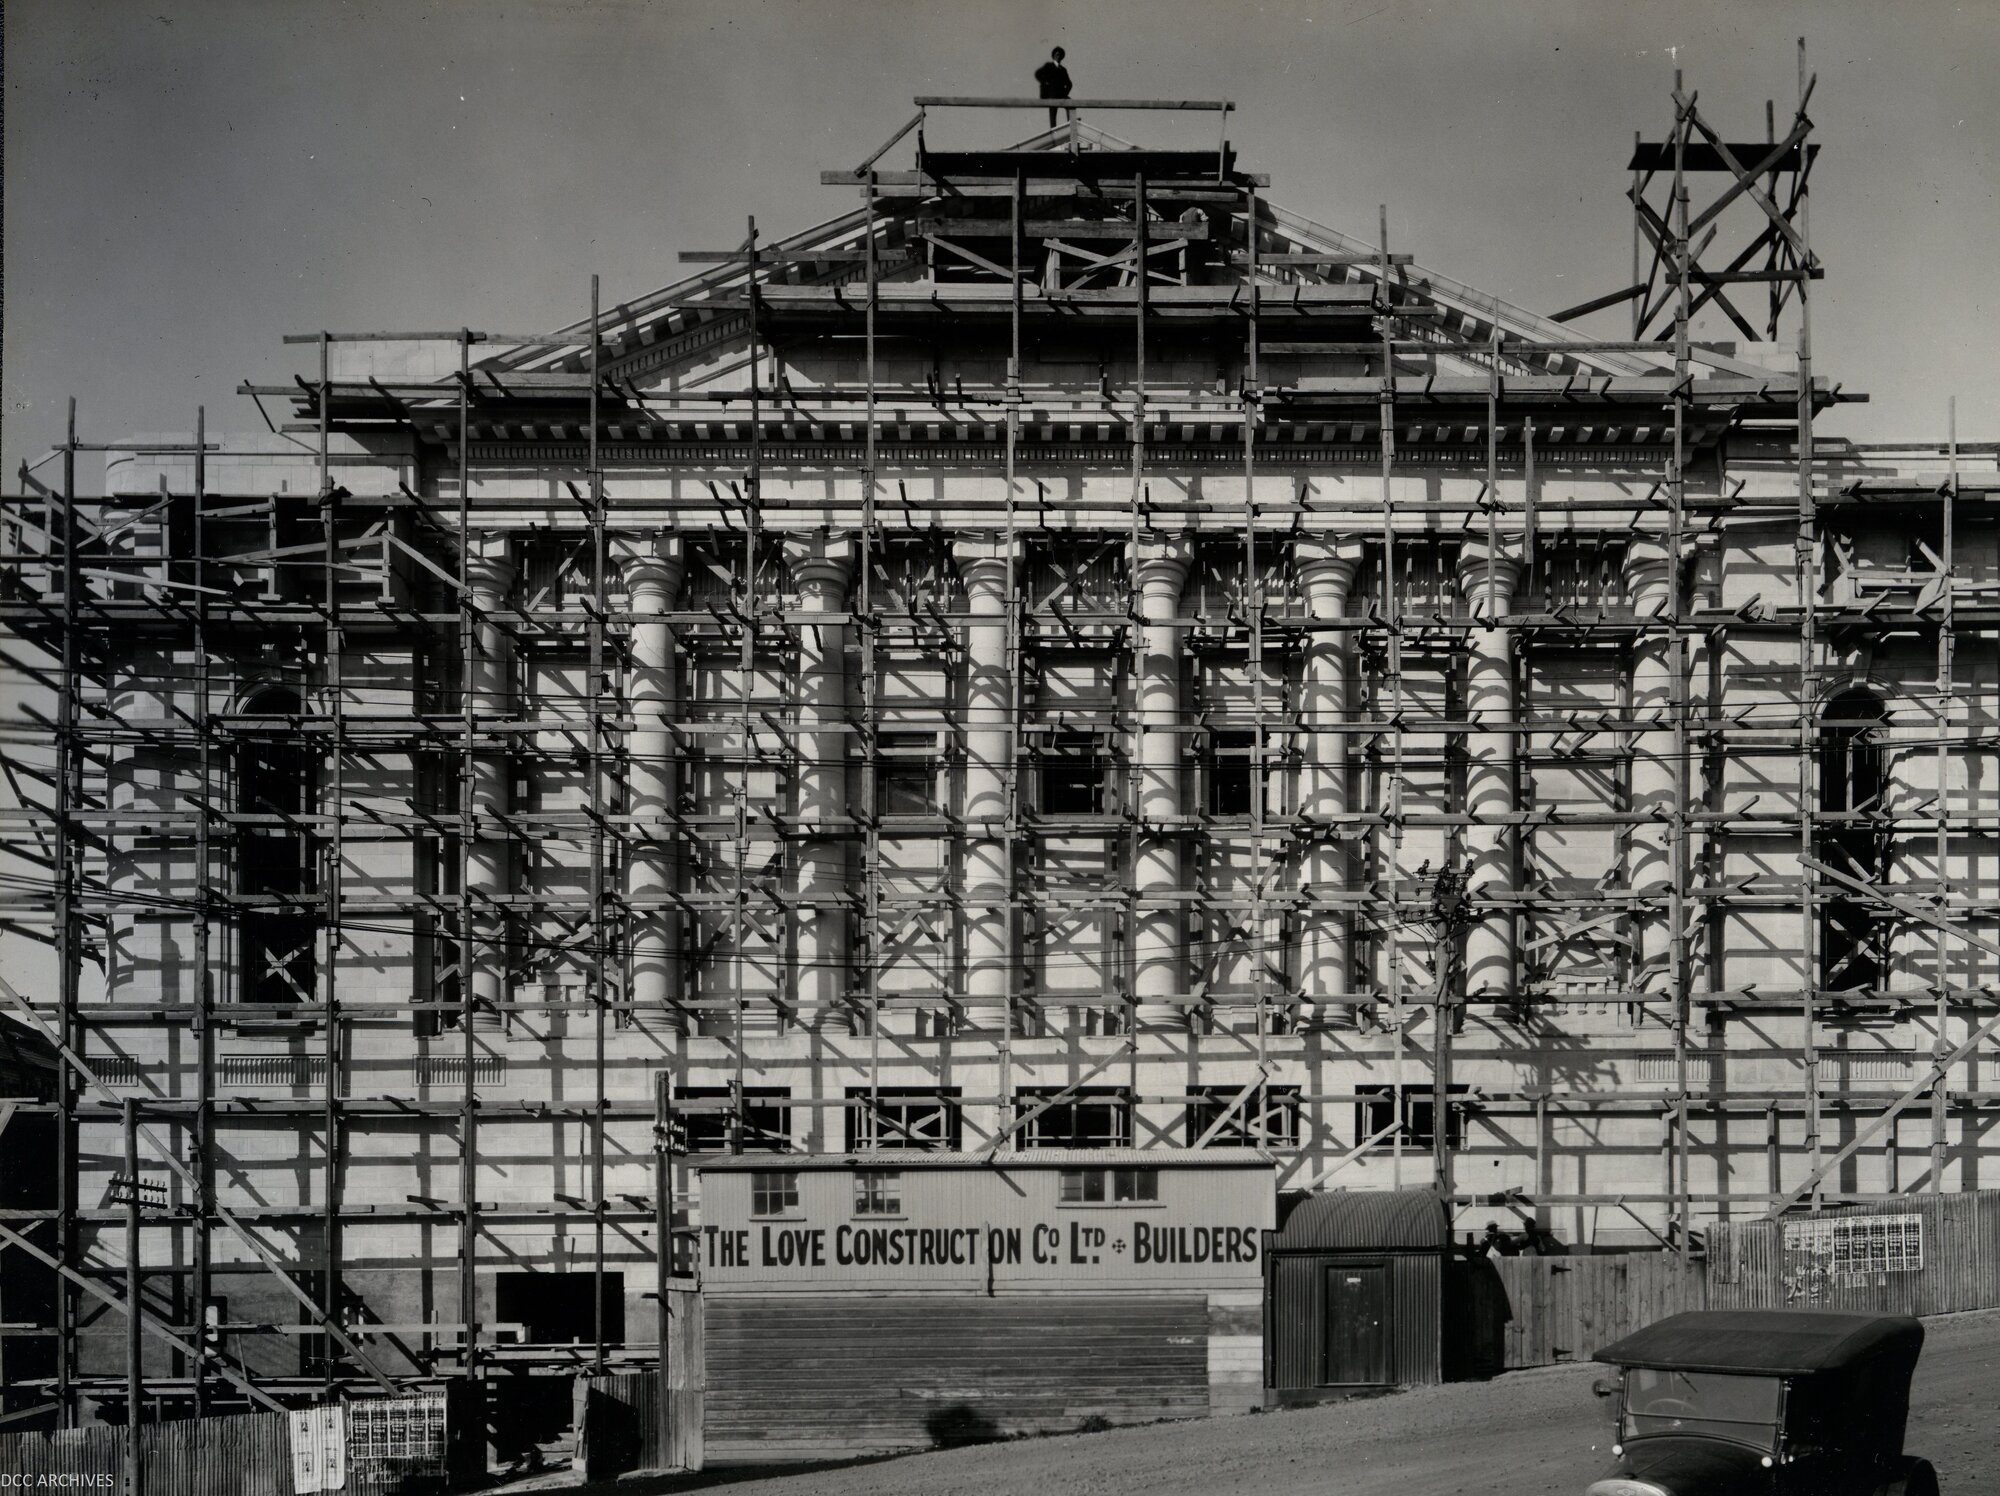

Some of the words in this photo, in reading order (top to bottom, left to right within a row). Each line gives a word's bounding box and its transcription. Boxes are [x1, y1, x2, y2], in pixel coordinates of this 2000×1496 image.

[704, 1225, 749, 1267] THE
[762, 1225, 826, 1267] LOVE
[836, 1224, 1021, 1266] CONSTRUCTON
[1134, 1221, 1258, 1264] BUILDERS
